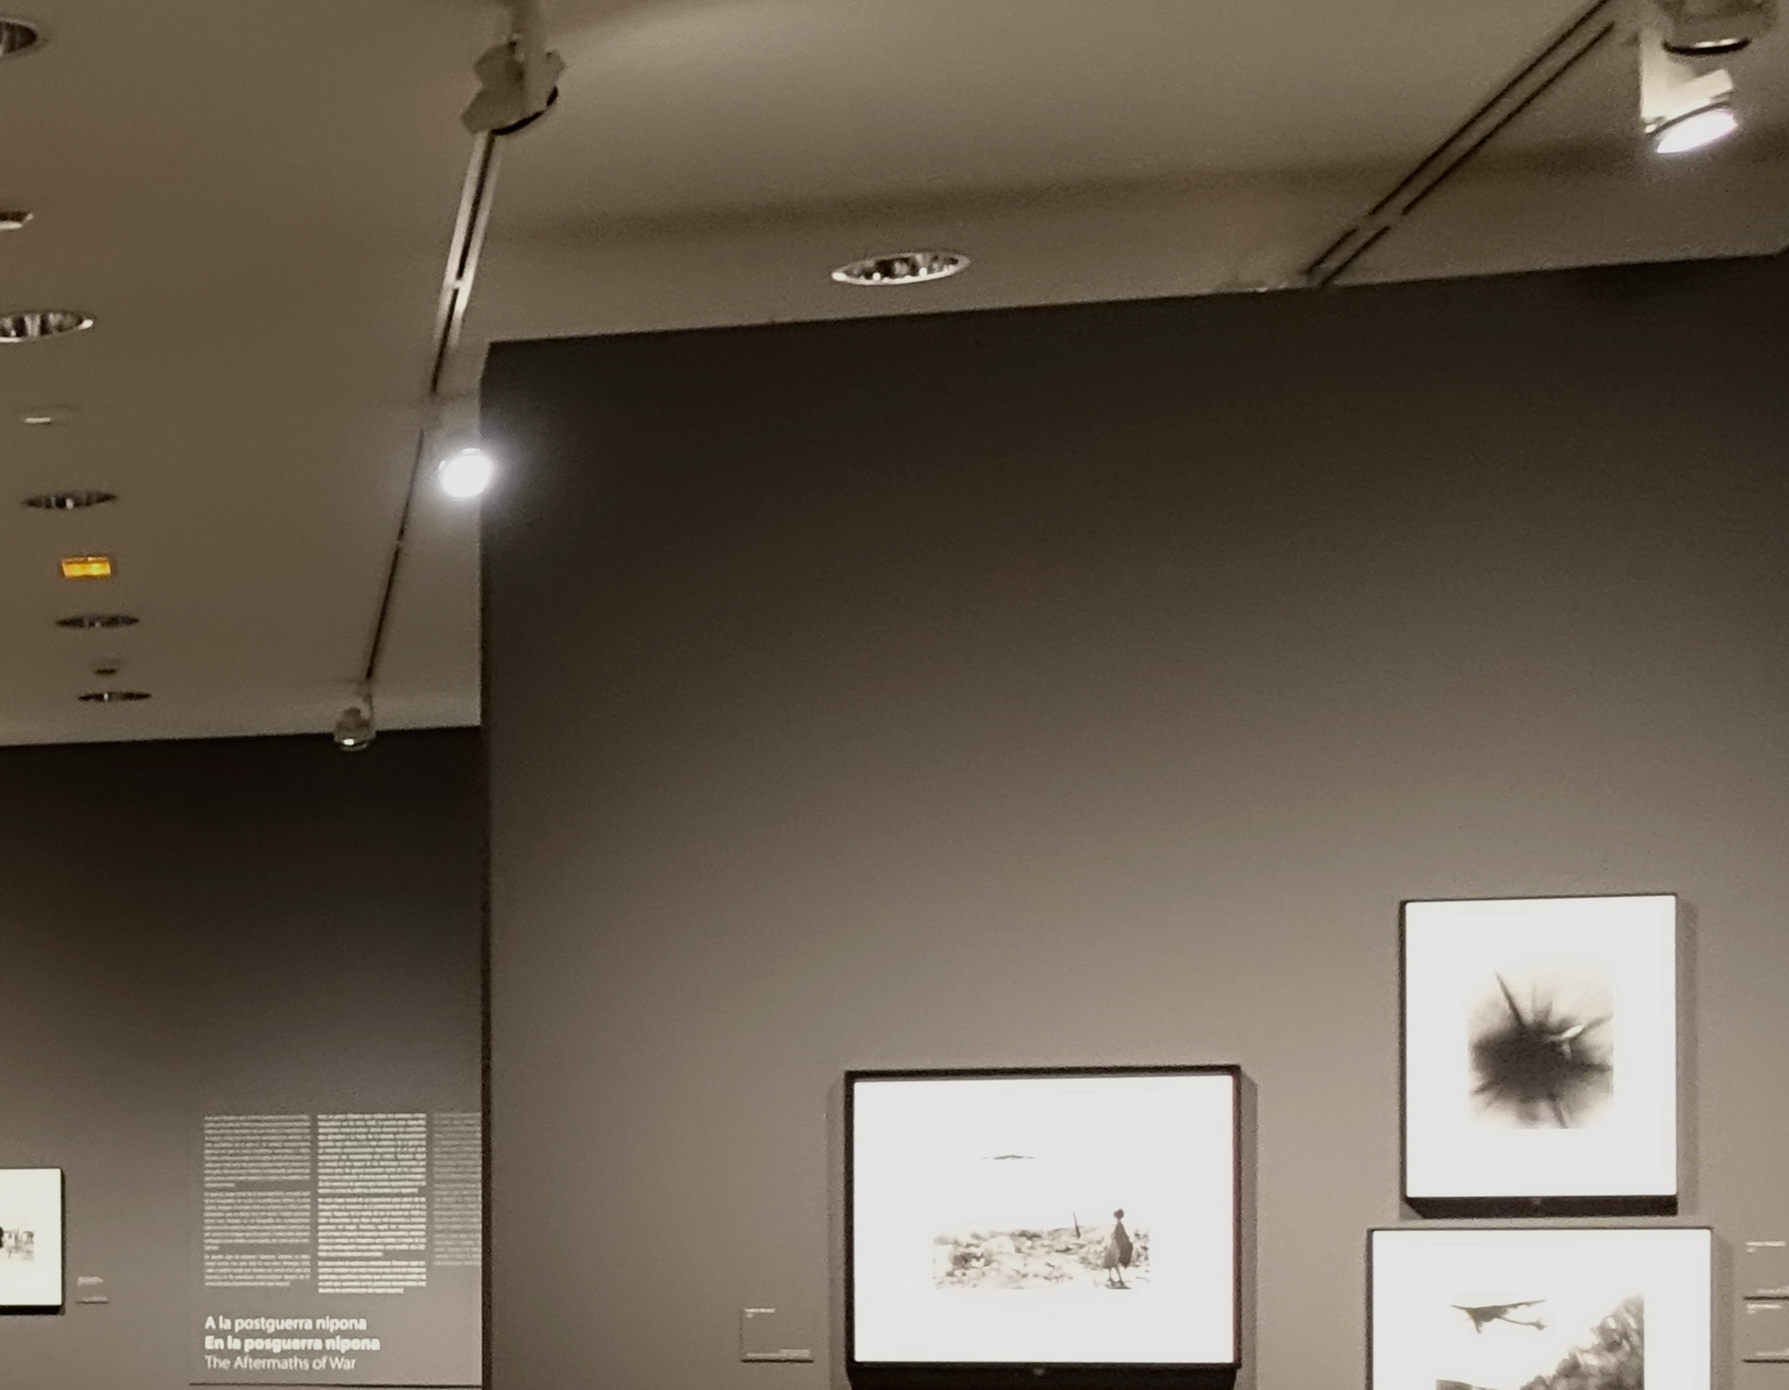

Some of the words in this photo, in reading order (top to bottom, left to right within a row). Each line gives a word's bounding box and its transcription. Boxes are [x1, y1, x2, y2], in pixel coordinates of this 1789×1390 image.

[204, 1315, 216, 1330] A
[218, 1315, 232, 1330] la
[234, 1316, 313, 1334] postguerra
[315, 1314, 368, 1334] nipona
[204, 1335, 225, 1350] En
[226, 1334, 242, 1350] la
[243, 1338, 323, 1354] posguerra
[324, 1334, 381, 1354] nipona
[204, 1355, 231, 1370] The
[233, 1355, 310, 1371] Aftermaths
[311, 1355, 328, 1371] of
[328, 1356, 357, 1371] War
